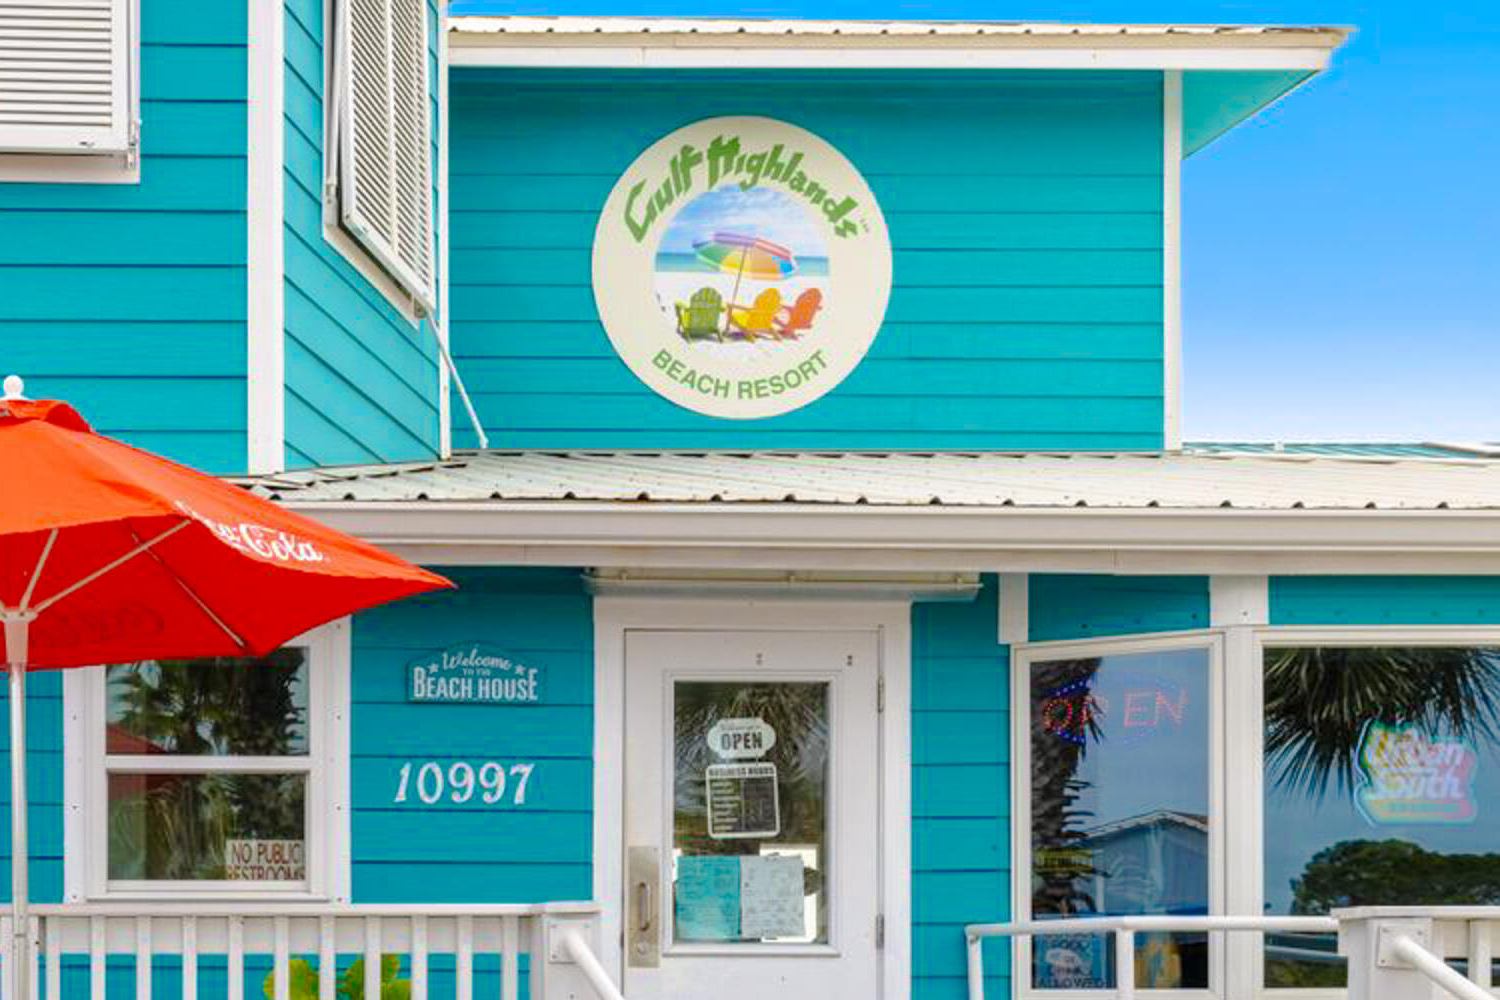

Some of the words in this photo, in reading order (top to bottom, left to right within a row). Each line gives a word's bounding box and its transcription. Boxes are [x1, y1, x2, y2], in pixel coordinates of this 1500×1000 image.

[623, 145, 703, 244] Gulf
[706, 135, 860, 239] Highlands
[652, 348, 730, 399] BEACH
[737, 350, 829, 400] RESORT
[442, 646, 513, 671] Welcome
[413, 666, 473, 699] BEACH
[477, 668, 539, 701] HOUSE
[721, 731, 763, 750] OPEN
[393, 762, 536, 805] 10997
[231, 843, 253, 864] NO
[257, 843, 301, 864] PUBLIC
